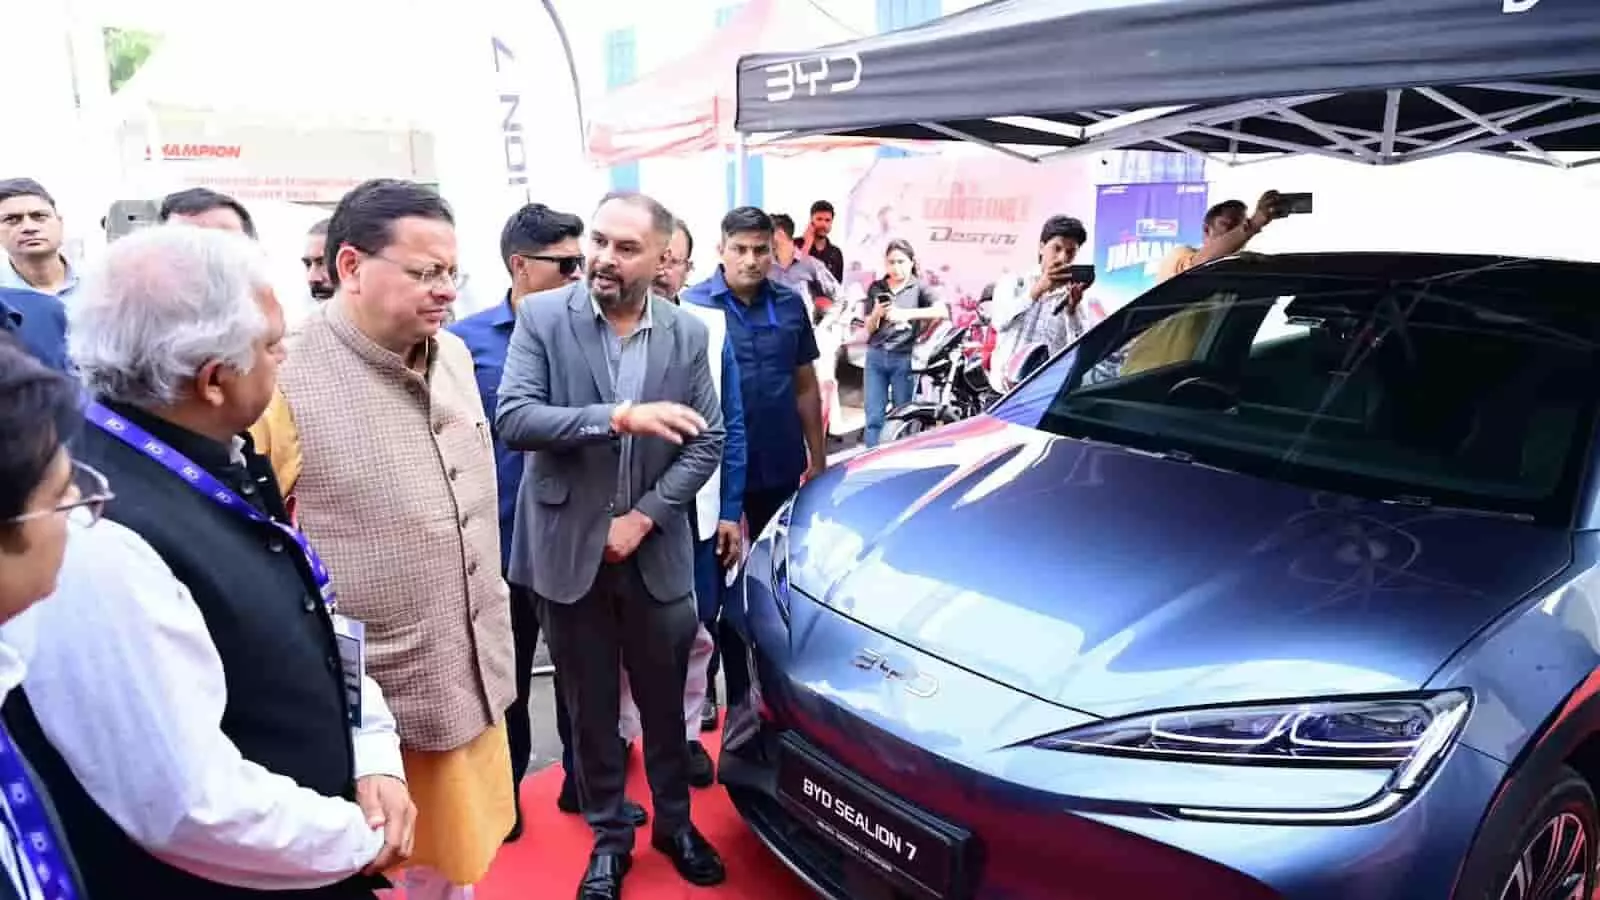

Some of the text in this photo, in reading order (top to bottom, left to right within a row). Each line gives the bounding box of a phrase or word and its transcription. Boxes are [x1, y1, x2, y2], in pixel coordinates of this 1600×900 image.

[765, 53, 863, 102] BYD
[145, 144, 242, 158] HAMPION
[851, 648, 939, 697] BYD
[803, 777, 832, 809] BYD
[834, 798, 901, 854] SEALION
[905, 841, 917, 861] 7
